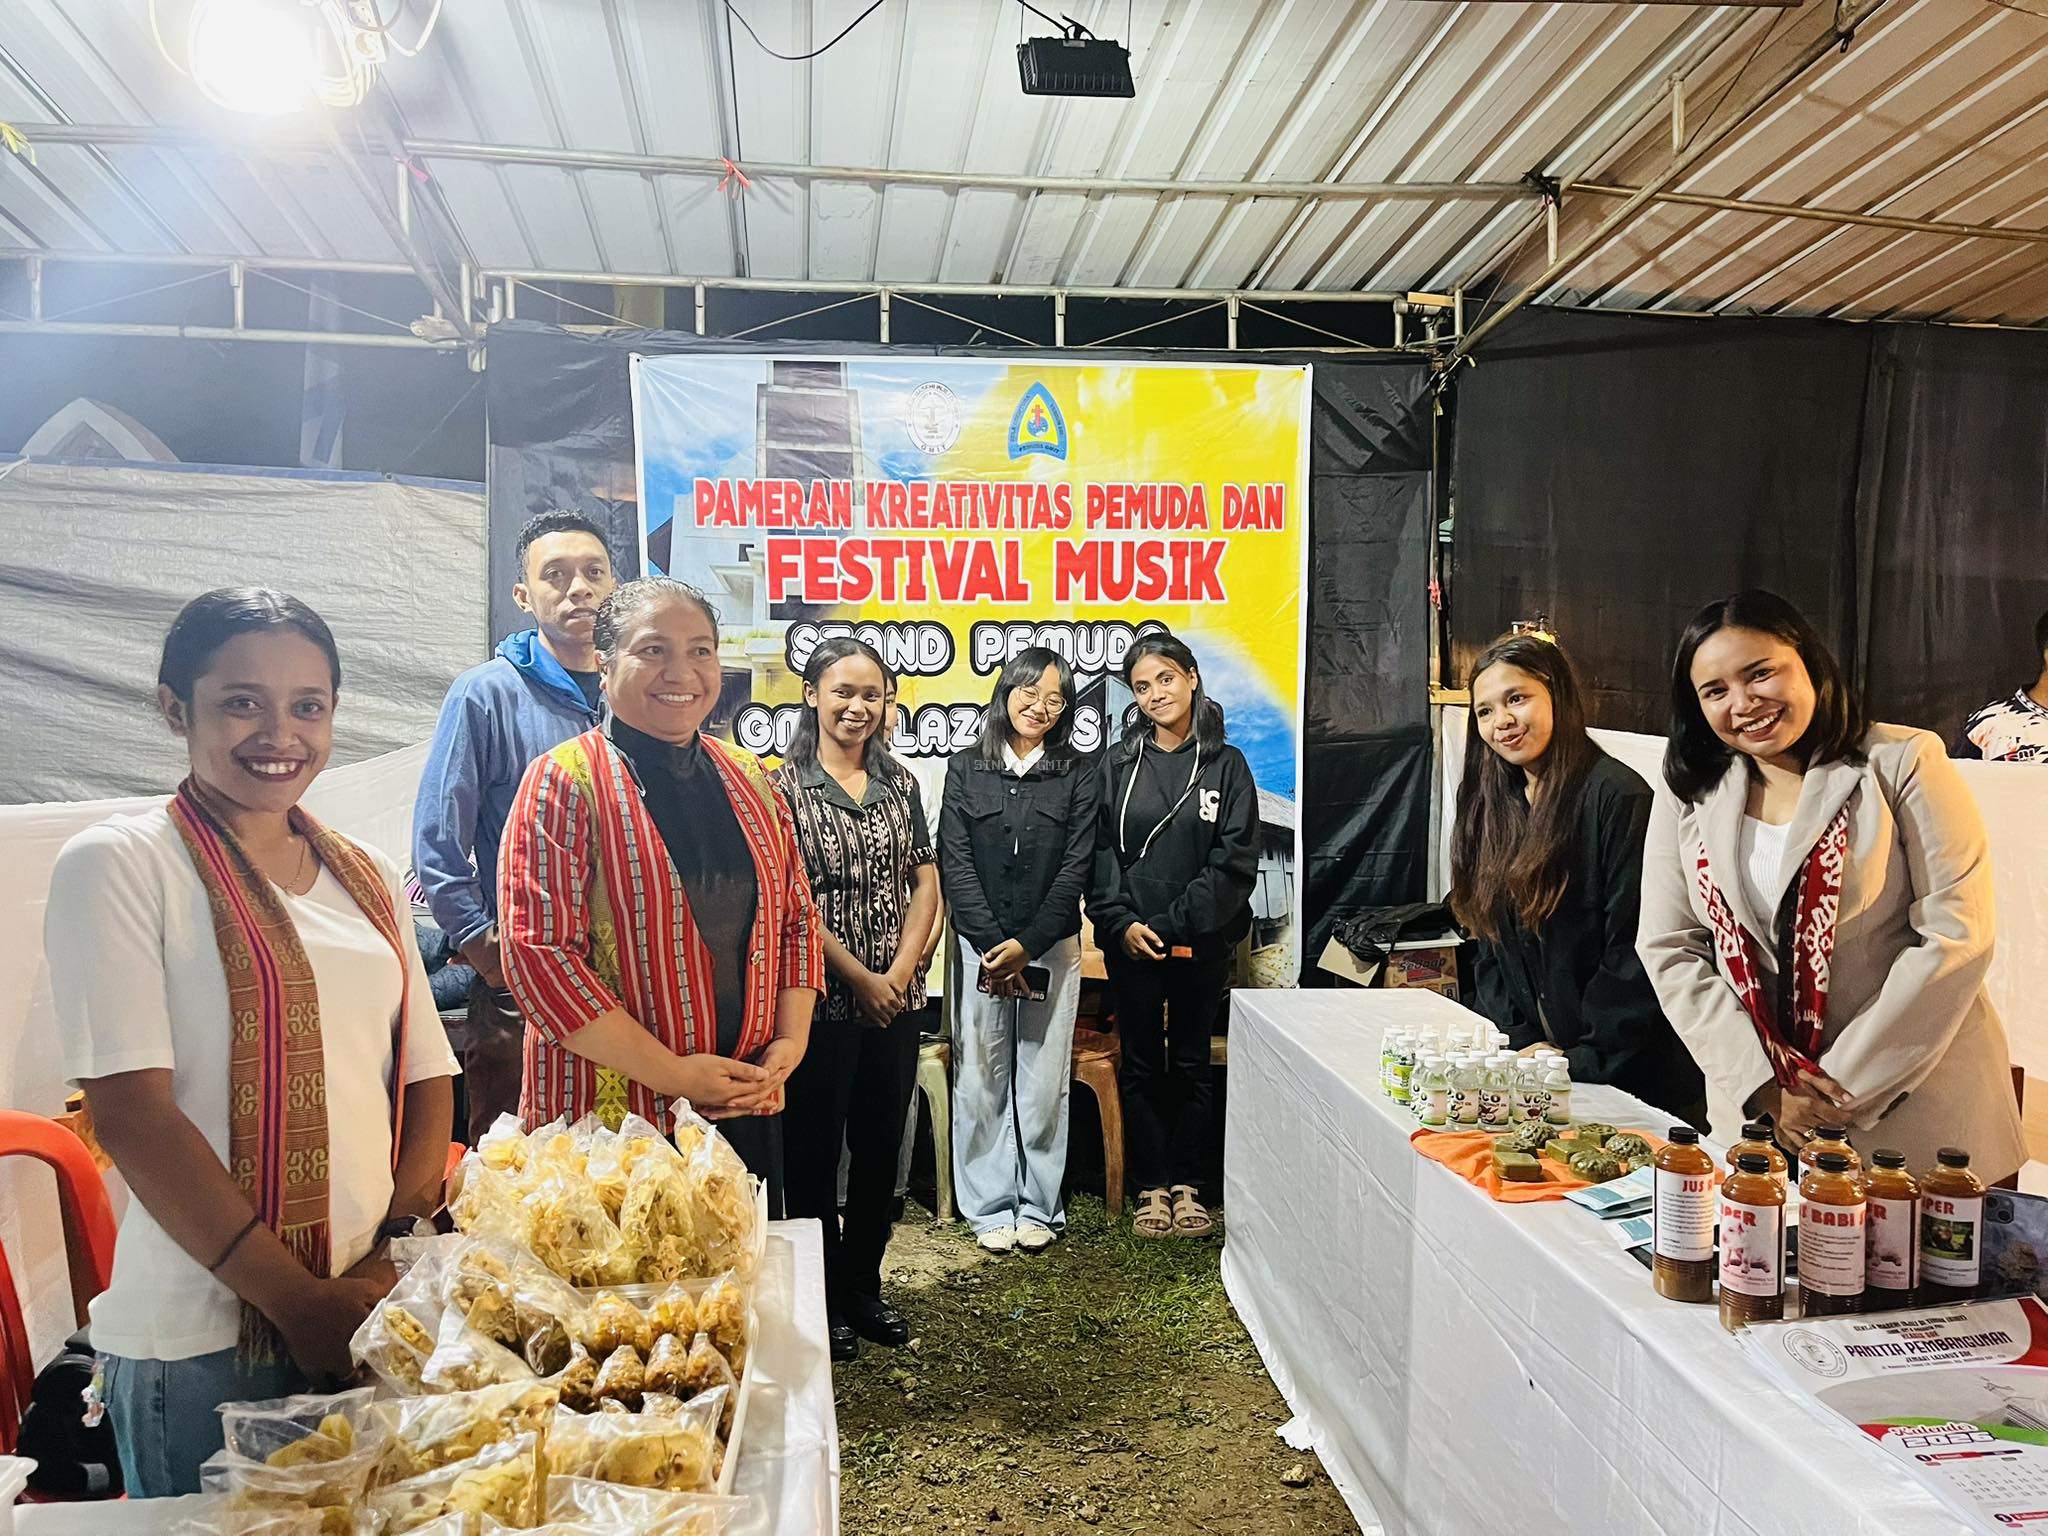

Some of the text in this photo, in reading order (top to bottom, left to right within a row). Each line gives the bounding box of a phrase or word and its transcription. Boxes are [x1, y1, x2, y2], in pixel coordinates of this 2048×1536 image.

[694, 478, 1285, 531] PAMERAN KREATIVITAS PEMUDA DAN
[766, 537, 1229, 603] FESTIVAL MUSIK
[972, 622, 1168, 674] PEMUD
[1682, 1180, 1705, 1192] JUS
[1811, 1208, 1855, 1228] BABI
[1844, 1341, 1907, 1357] PANITIA
[1904, 1331, 2013, 1355] PEMBANGUNAN
[1891, 1423, 1977, 1437] Kalender
